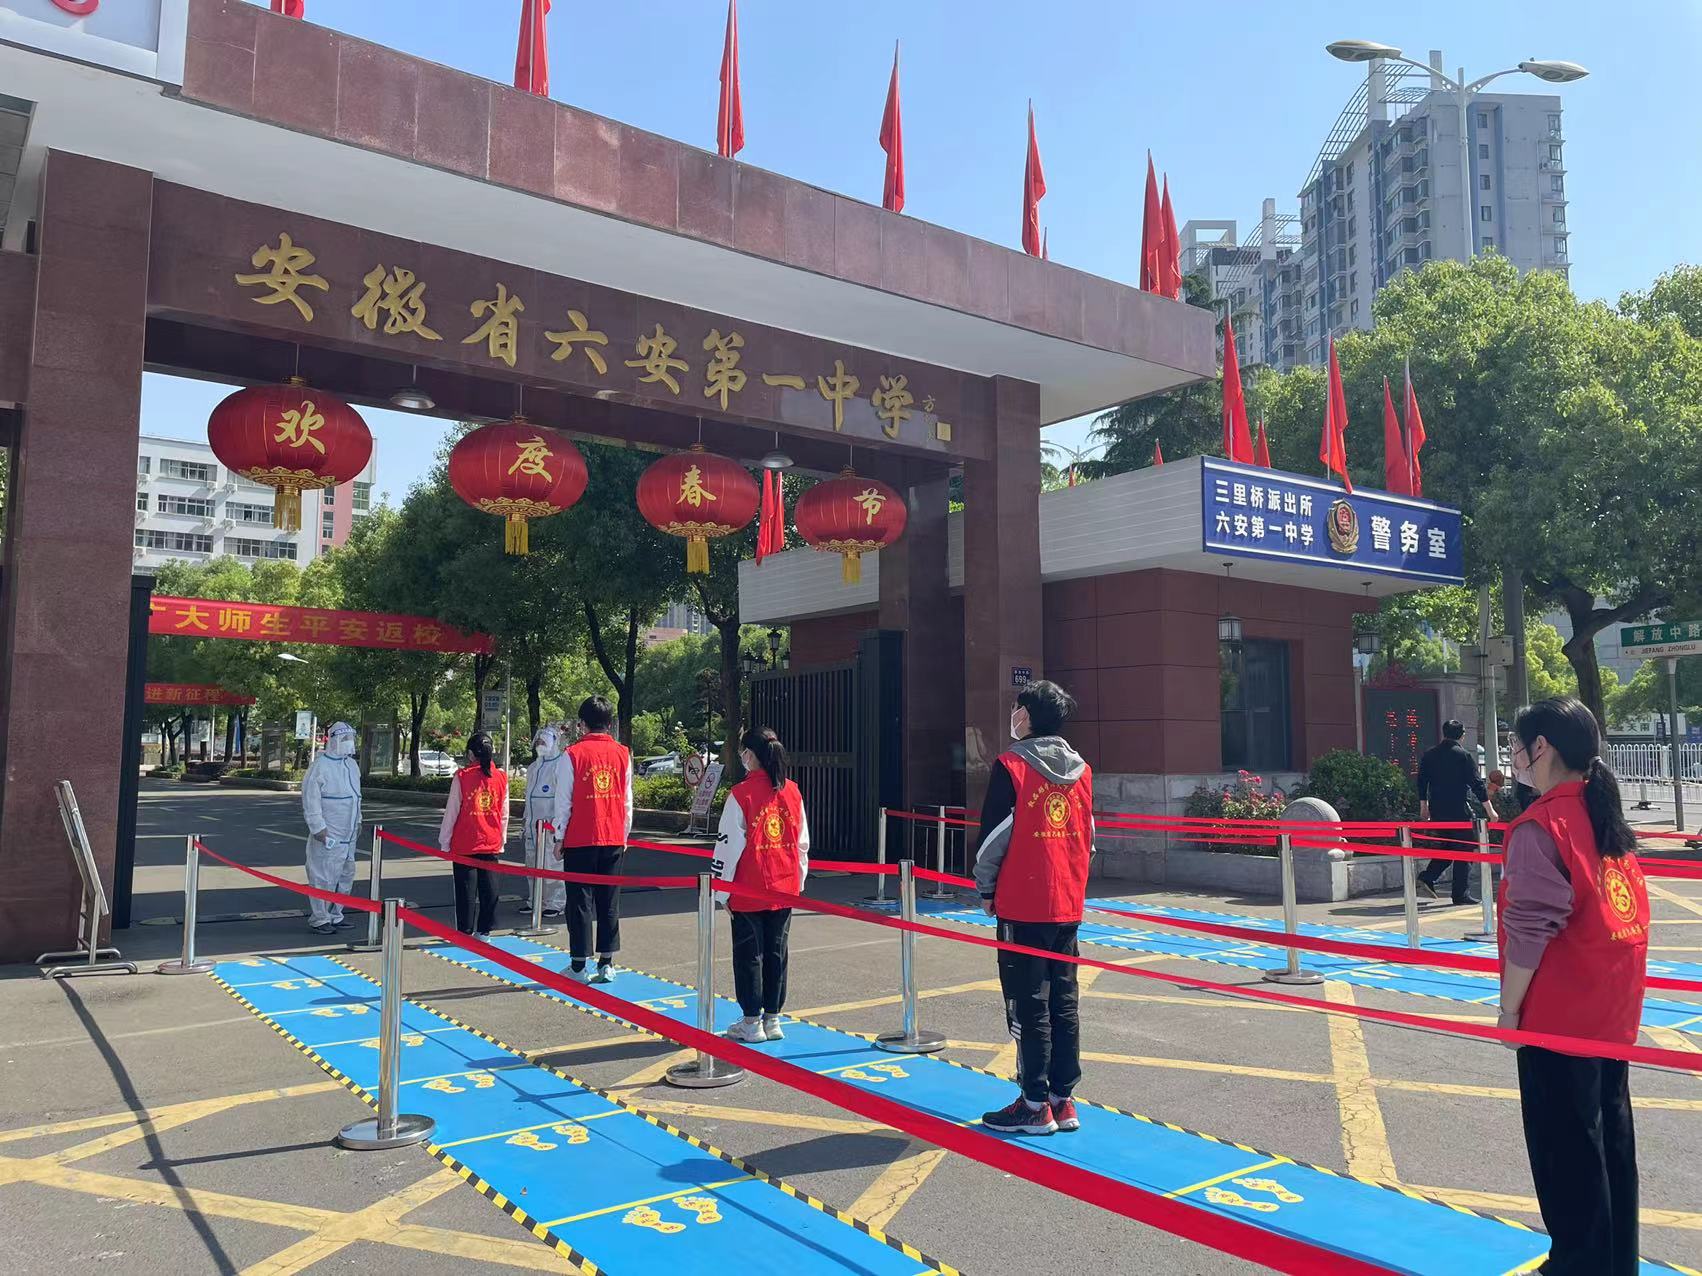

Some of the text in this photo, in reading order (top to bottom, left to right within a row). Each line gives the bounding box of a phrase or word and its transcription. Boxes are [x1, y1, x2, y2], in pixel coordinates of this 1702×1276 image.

[235, 232, 914, 439] 安徽省六安第一中学
[274, 401, 326, 454] 欢
[508, 437, 553, 482] 度
[676, 465, 716, 507] 春
[853, 488, 887, 525] 节
[1215, 479, 1313, 518] 三里桥派出所
[1215, 510, 1315, 547] 六安第一中学
[1370, 515, 1447, 559] 警务室
[1633, 623, 1700, 643] 解放中路
